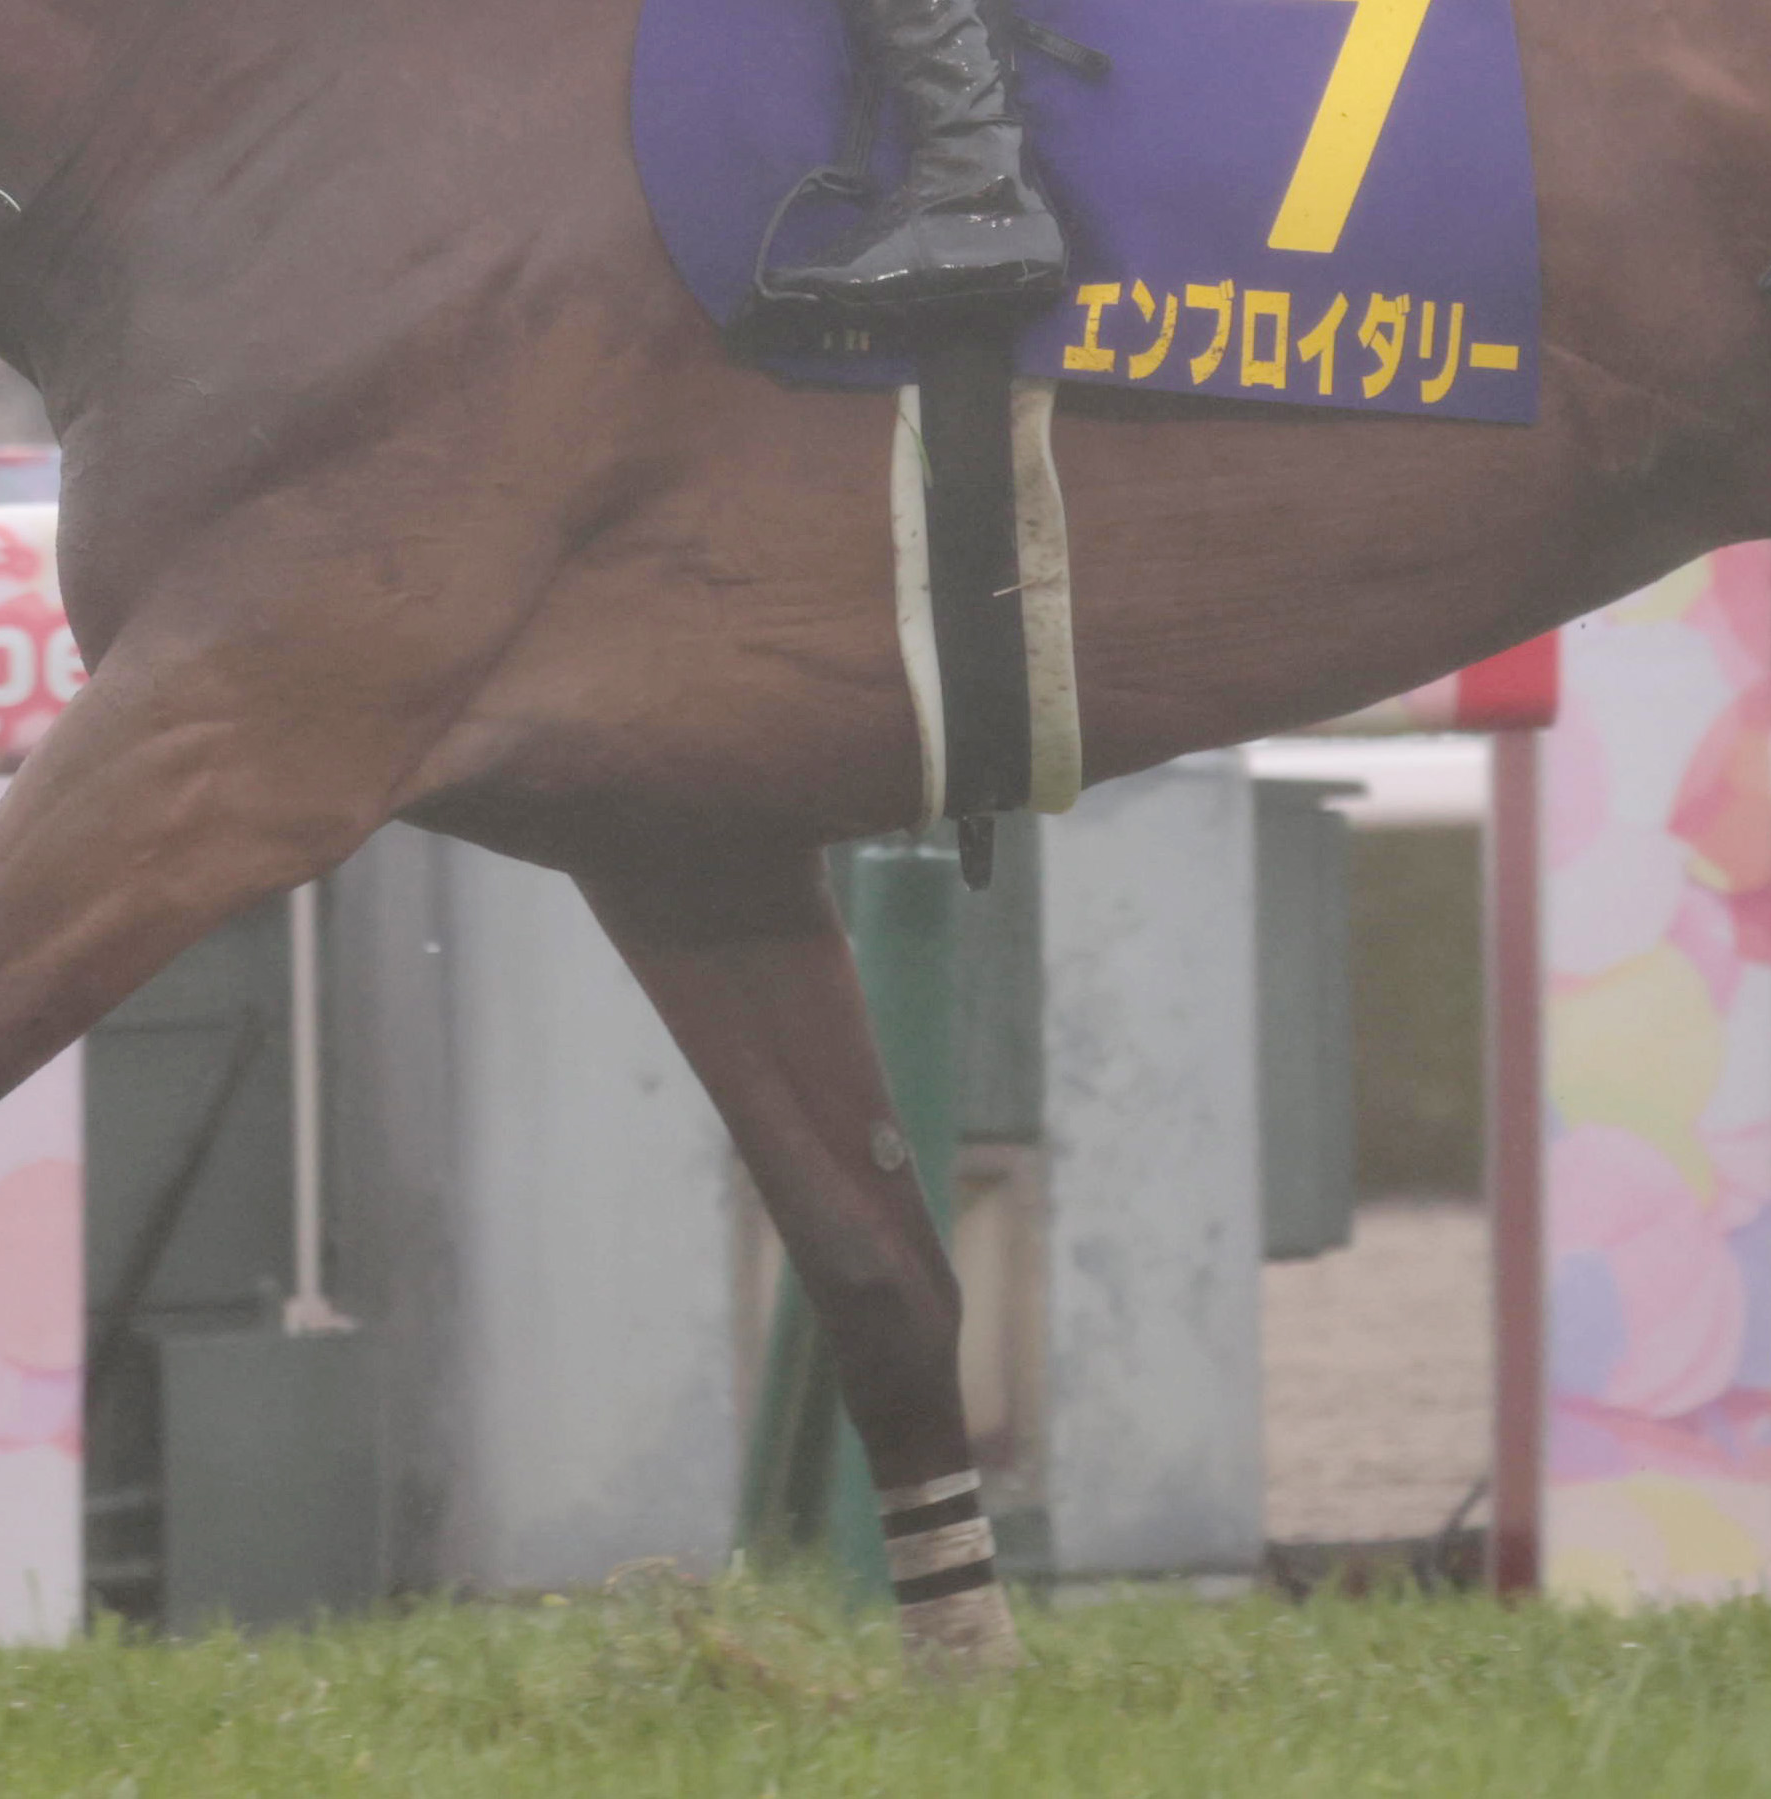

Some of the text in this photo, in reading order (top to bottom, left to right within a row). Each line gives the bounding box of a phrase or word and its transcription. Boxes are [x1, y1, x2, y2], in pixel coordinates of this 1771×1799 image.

[1062, 279, 1519, 403] エンブロイダリー
